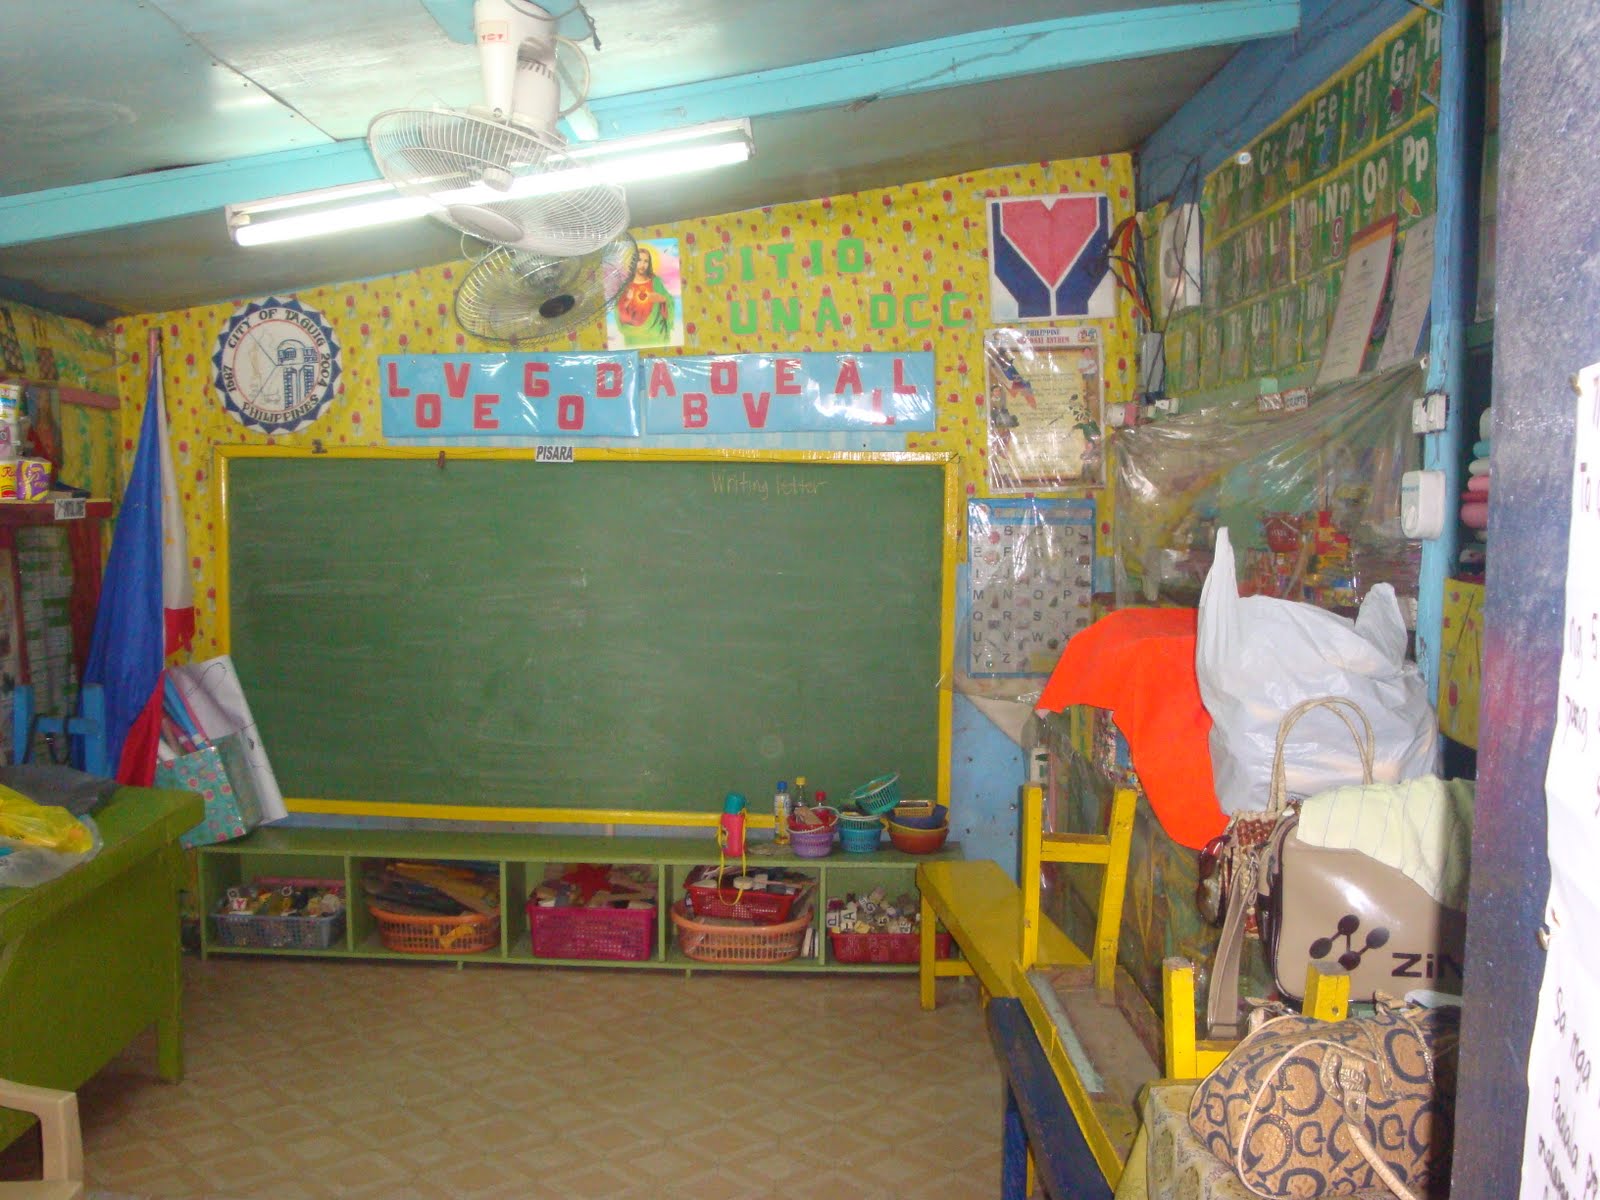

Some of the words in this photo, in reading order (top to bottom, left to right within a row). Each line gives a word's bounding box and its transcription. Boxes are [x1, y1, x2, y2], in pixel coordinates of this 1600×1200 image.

[1315, 93, 1338, 137] Ee
[1354, 63, 1373, 114] Ff
[1390, 39, 1417, 88] Gg
[1325, 182, 1350, 223] Nn
[1362, 157, 1388, 204] Oo
[1402, 135, 1429, 182] Pp
[704, 238, 866, 286] SITIO
[730, 296, 843, 335] UNA
[227, 317, 252, 349] CITY
[259, 308, 278, 320] OF
[285, 309, 326, 347] TAGUIG
[1026, 329, 1060, 337] PHILIPPINE
[1046, 336, 1070, 344] ANTHEM
[317, 352, 332, 387] 2004
[242, 394, 320, 423] PHILIPPINES
[536, 445, 573, 461] PISARA
[711, 471, 769, 501] Writing
[775, 471, 830, 496] letter
[1004, 526, 1013, 536] B
[1064, 526, 1074, 536] D
[973, 547, 983, 557] E
[1003, 547, 1011, 557] F
[1063, 547, 1073, 557] H
[1003, 568, 1010, 579] J
[1064, 568, 1072, 579] L
[972, 589, 984, 600] M
[1003, 589, 1012, 600] N
[1063, 589, 1072, 600] P
[972, 611, 983, 621] Q
[1003, 610, 1012, 621] R
[1033, 610, 1042, 621] S
[1063, 610, 1072, 620] T
[972, 631, 983, 642] U
[1002, 631, 1012, 642] V
[1033, 631, 1045, 642] W
[1062, 631, 1071, 641] X
[972, 653, 983, 664] Y
[1002, 653, 1011, 664] Z
